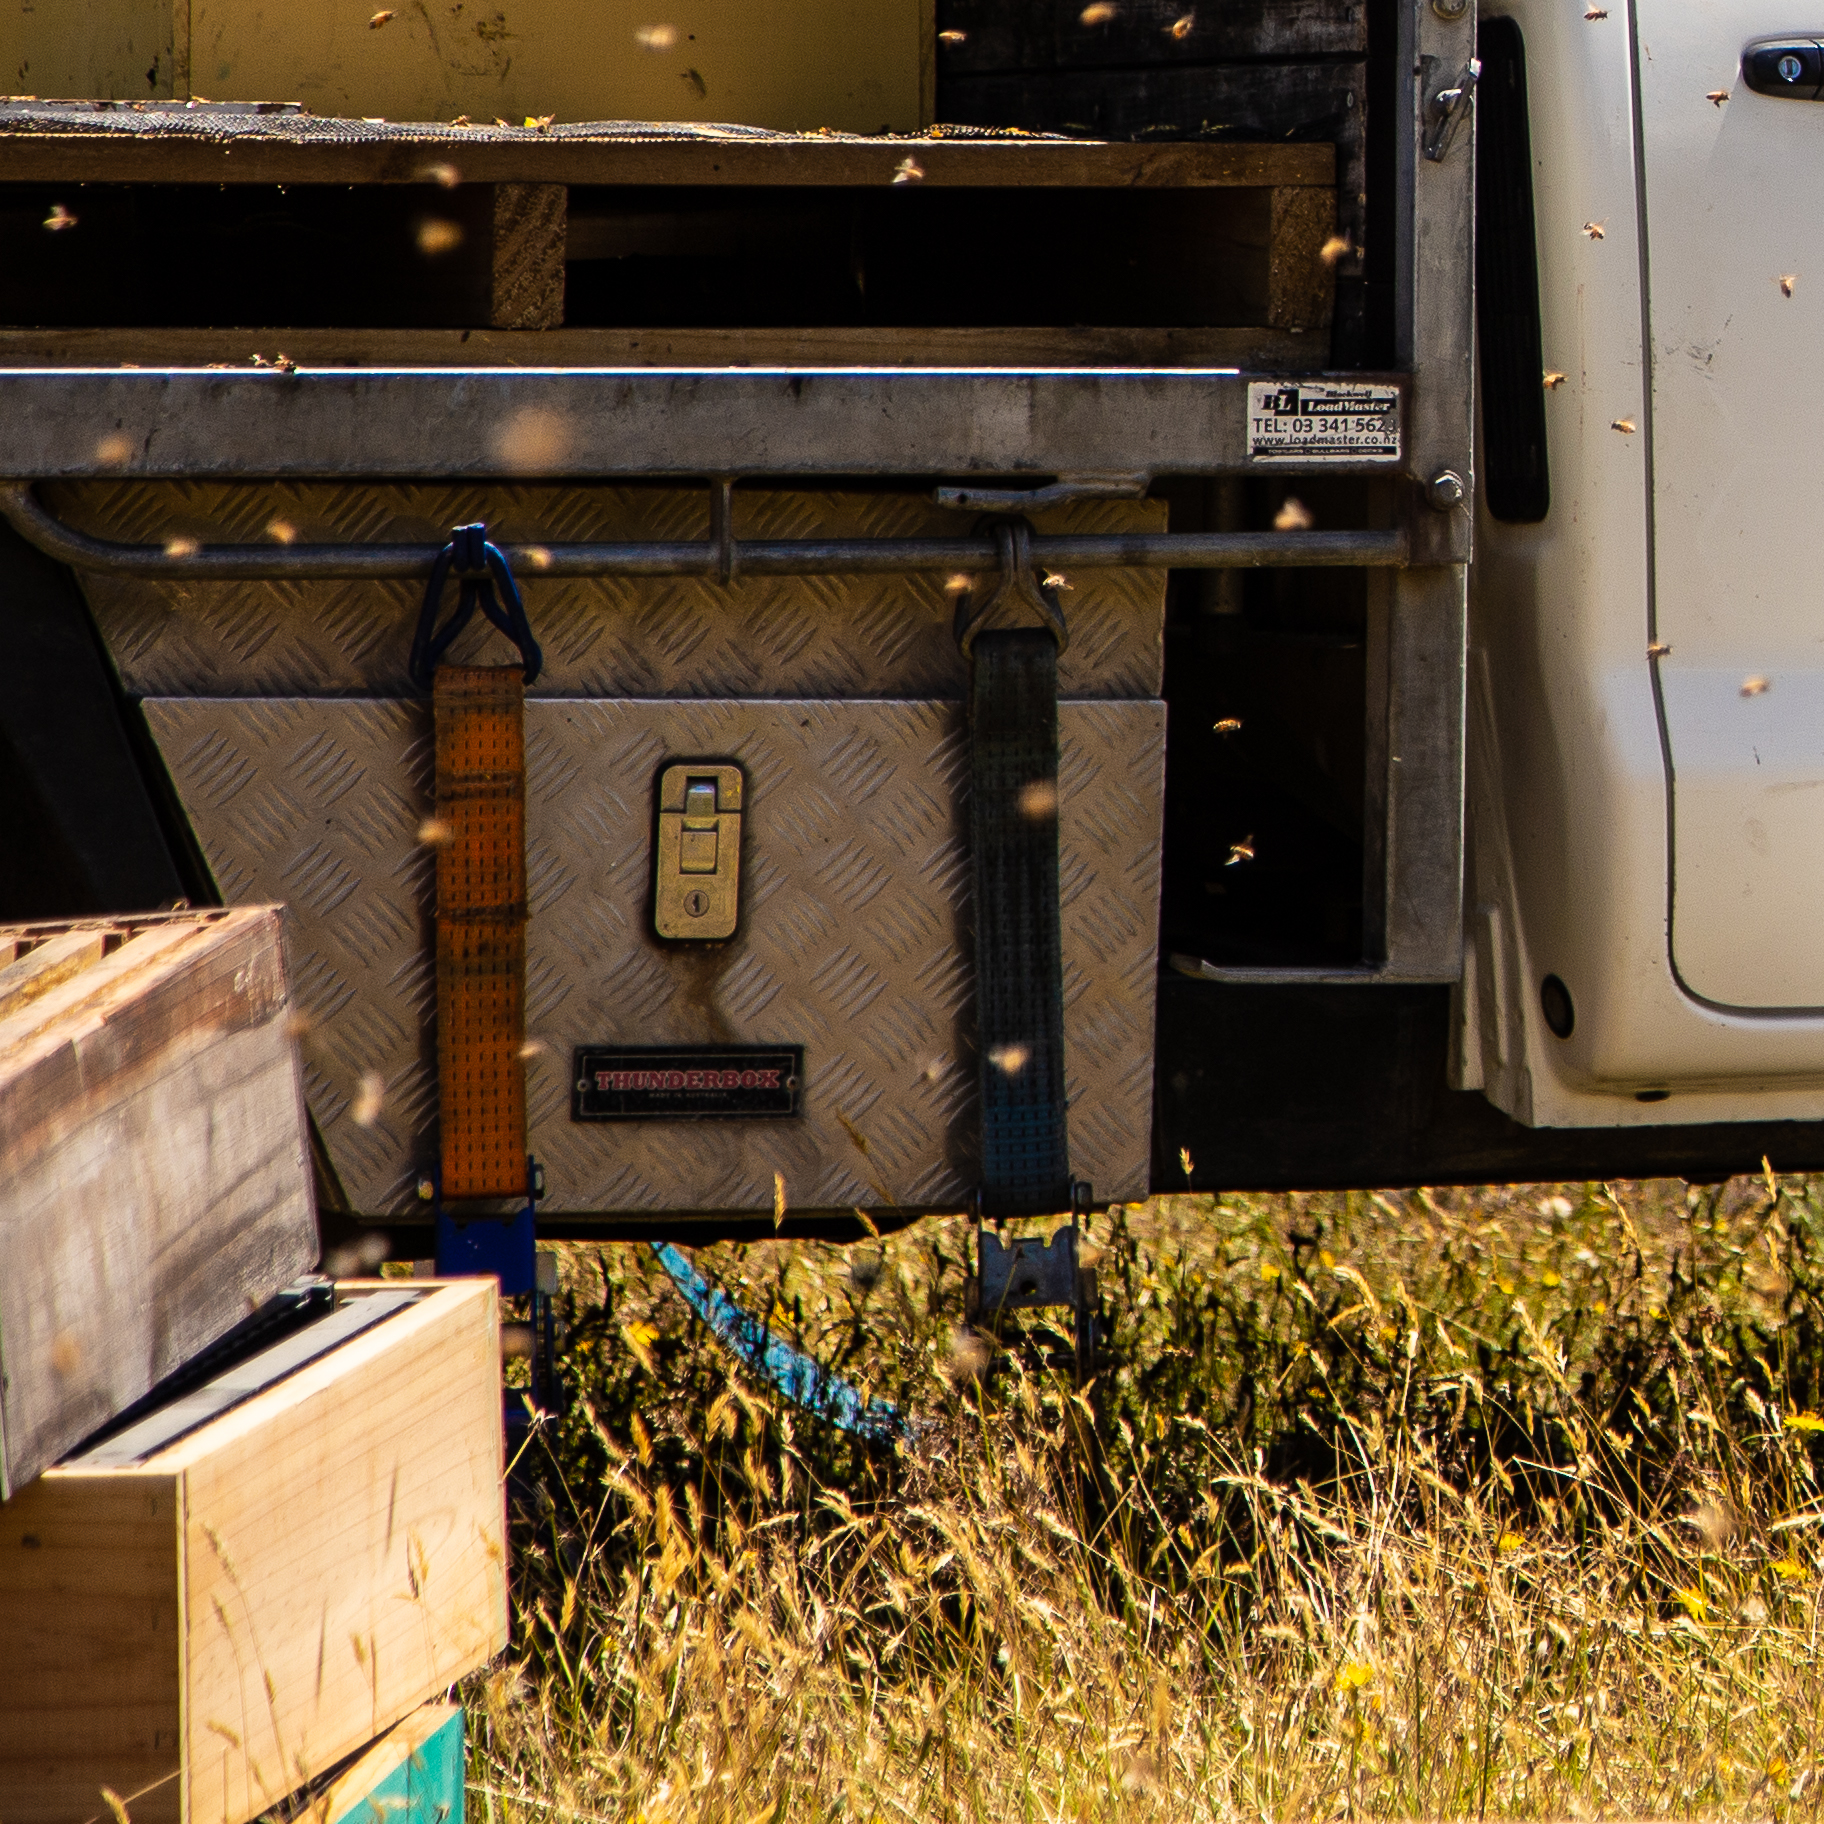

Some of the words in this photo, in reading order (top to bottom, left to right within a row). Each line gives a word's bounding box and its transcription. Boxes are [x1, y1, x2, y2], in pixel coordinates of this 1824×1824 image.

[1253, 418, 1287, 433] TEL:
[1292, 418, 1313, 433] 03
[1319, 418, 1348, 433] 341
[1253, 434, 1397, 445] www.loadmaster.co.nz
[595, 1070, 781, 1090] THUNDERBOX
